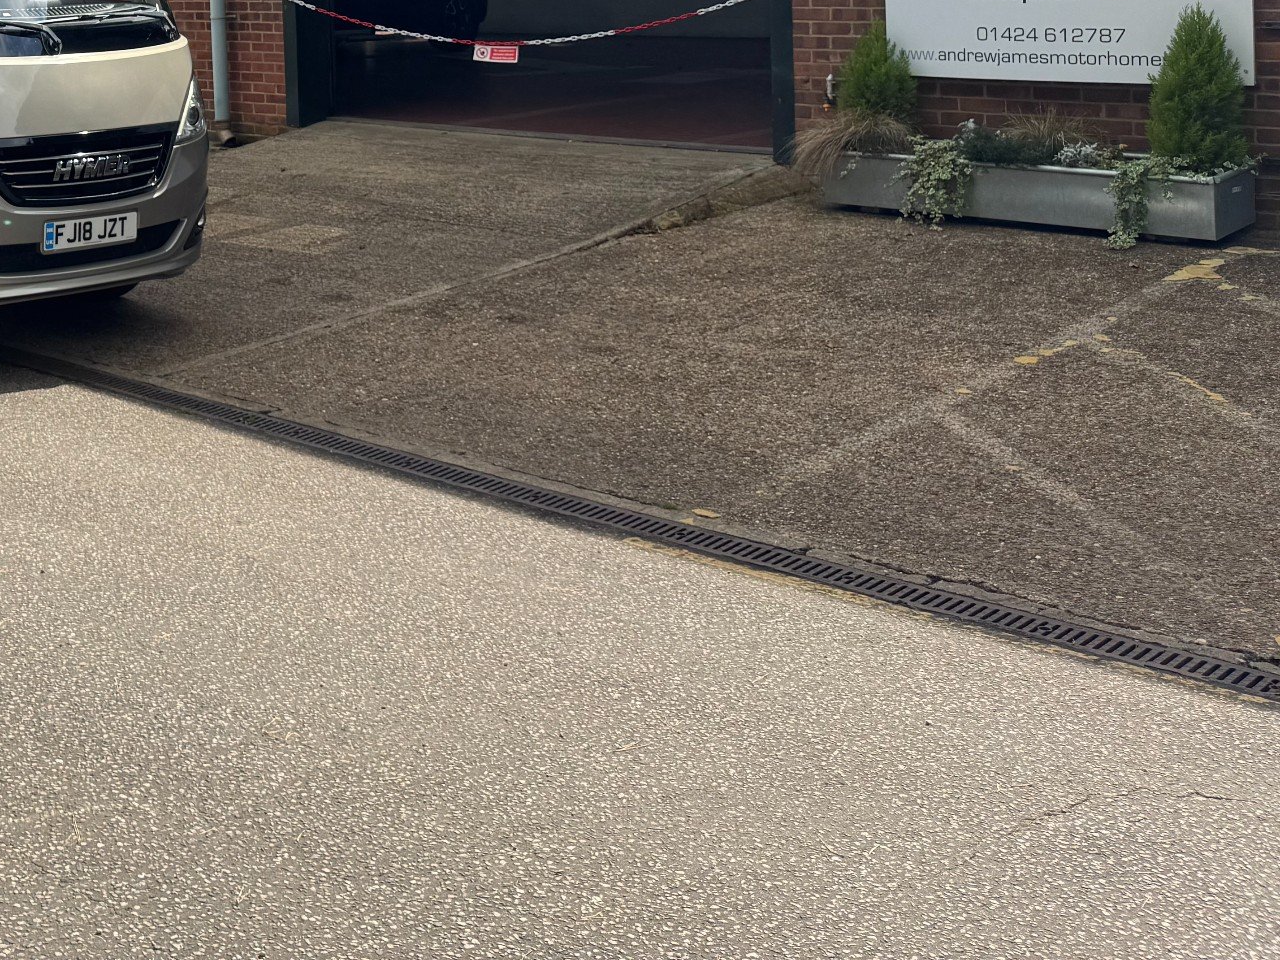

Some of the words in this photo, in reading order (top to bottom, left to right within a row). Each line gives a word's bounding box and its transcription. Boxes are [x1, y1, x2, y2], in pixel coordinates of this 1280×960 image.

[976, 26, 1039, 43] 01424
[1044, 27, 1126, 44] 612787
[53, 155, 130, 181] HYMER
[55, 221, 92, 244] FJ18
[97, 216, 127, 239] JZT
